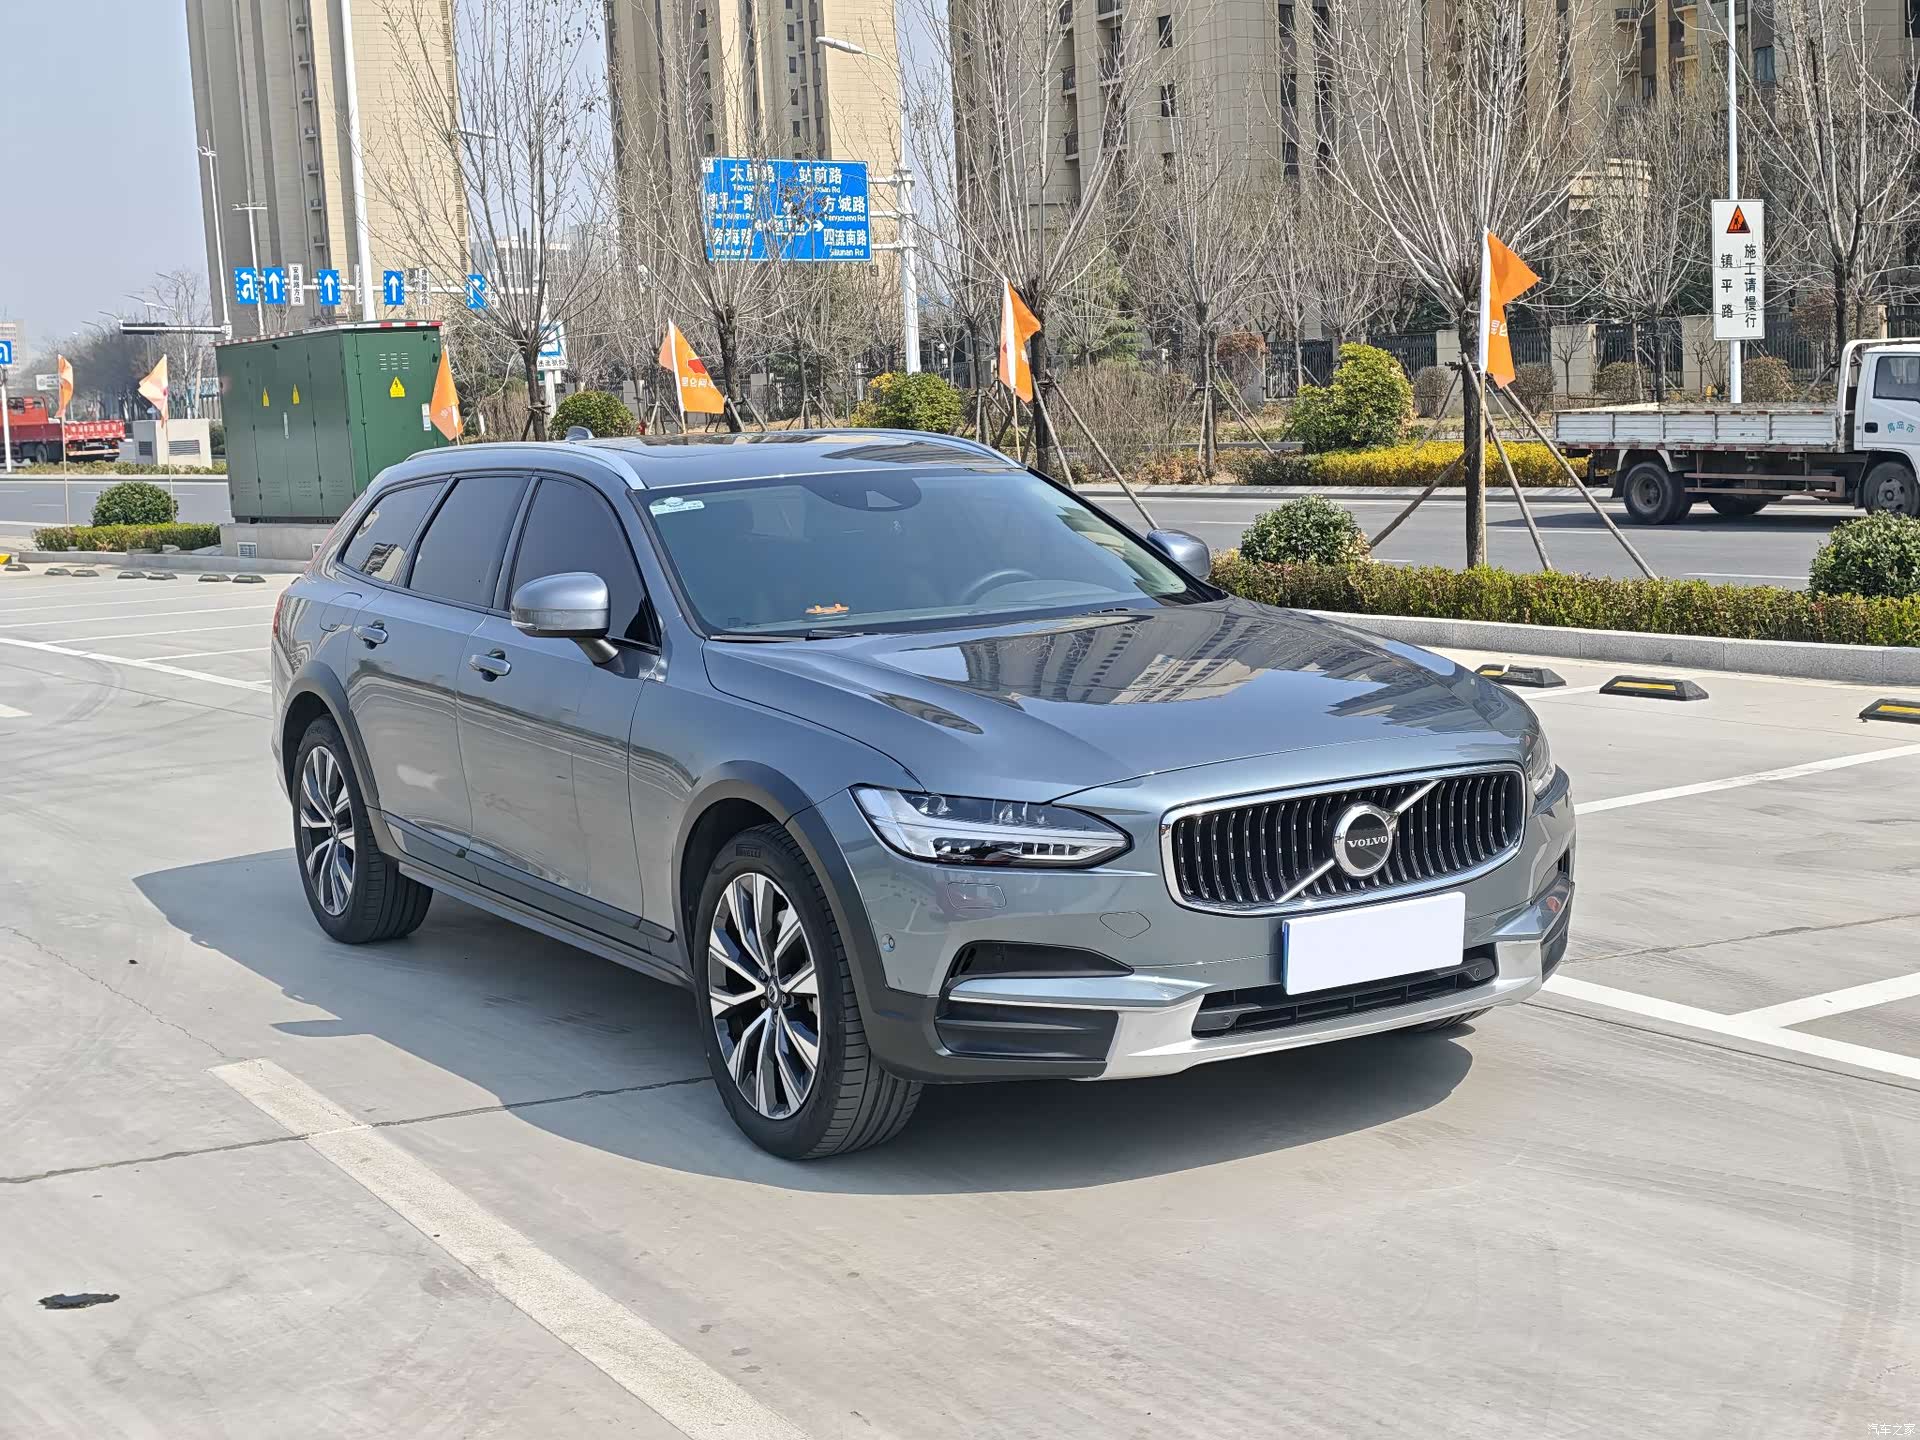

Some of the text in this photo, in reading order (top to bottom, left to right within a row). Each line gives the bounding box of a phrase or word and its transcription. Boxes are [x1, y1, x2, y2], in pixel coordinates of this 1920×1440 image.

[799, 166, 842, 184] 站前路
[822, 195, 866, 213] 方城路
[823, 229, 867, 246] 四流南路
[1720, 253, 1734, 319] 镇平路
[1744, 243, 1757, 328] 施工请慢行
[1347, 836, 1388, 848] VOLVO
